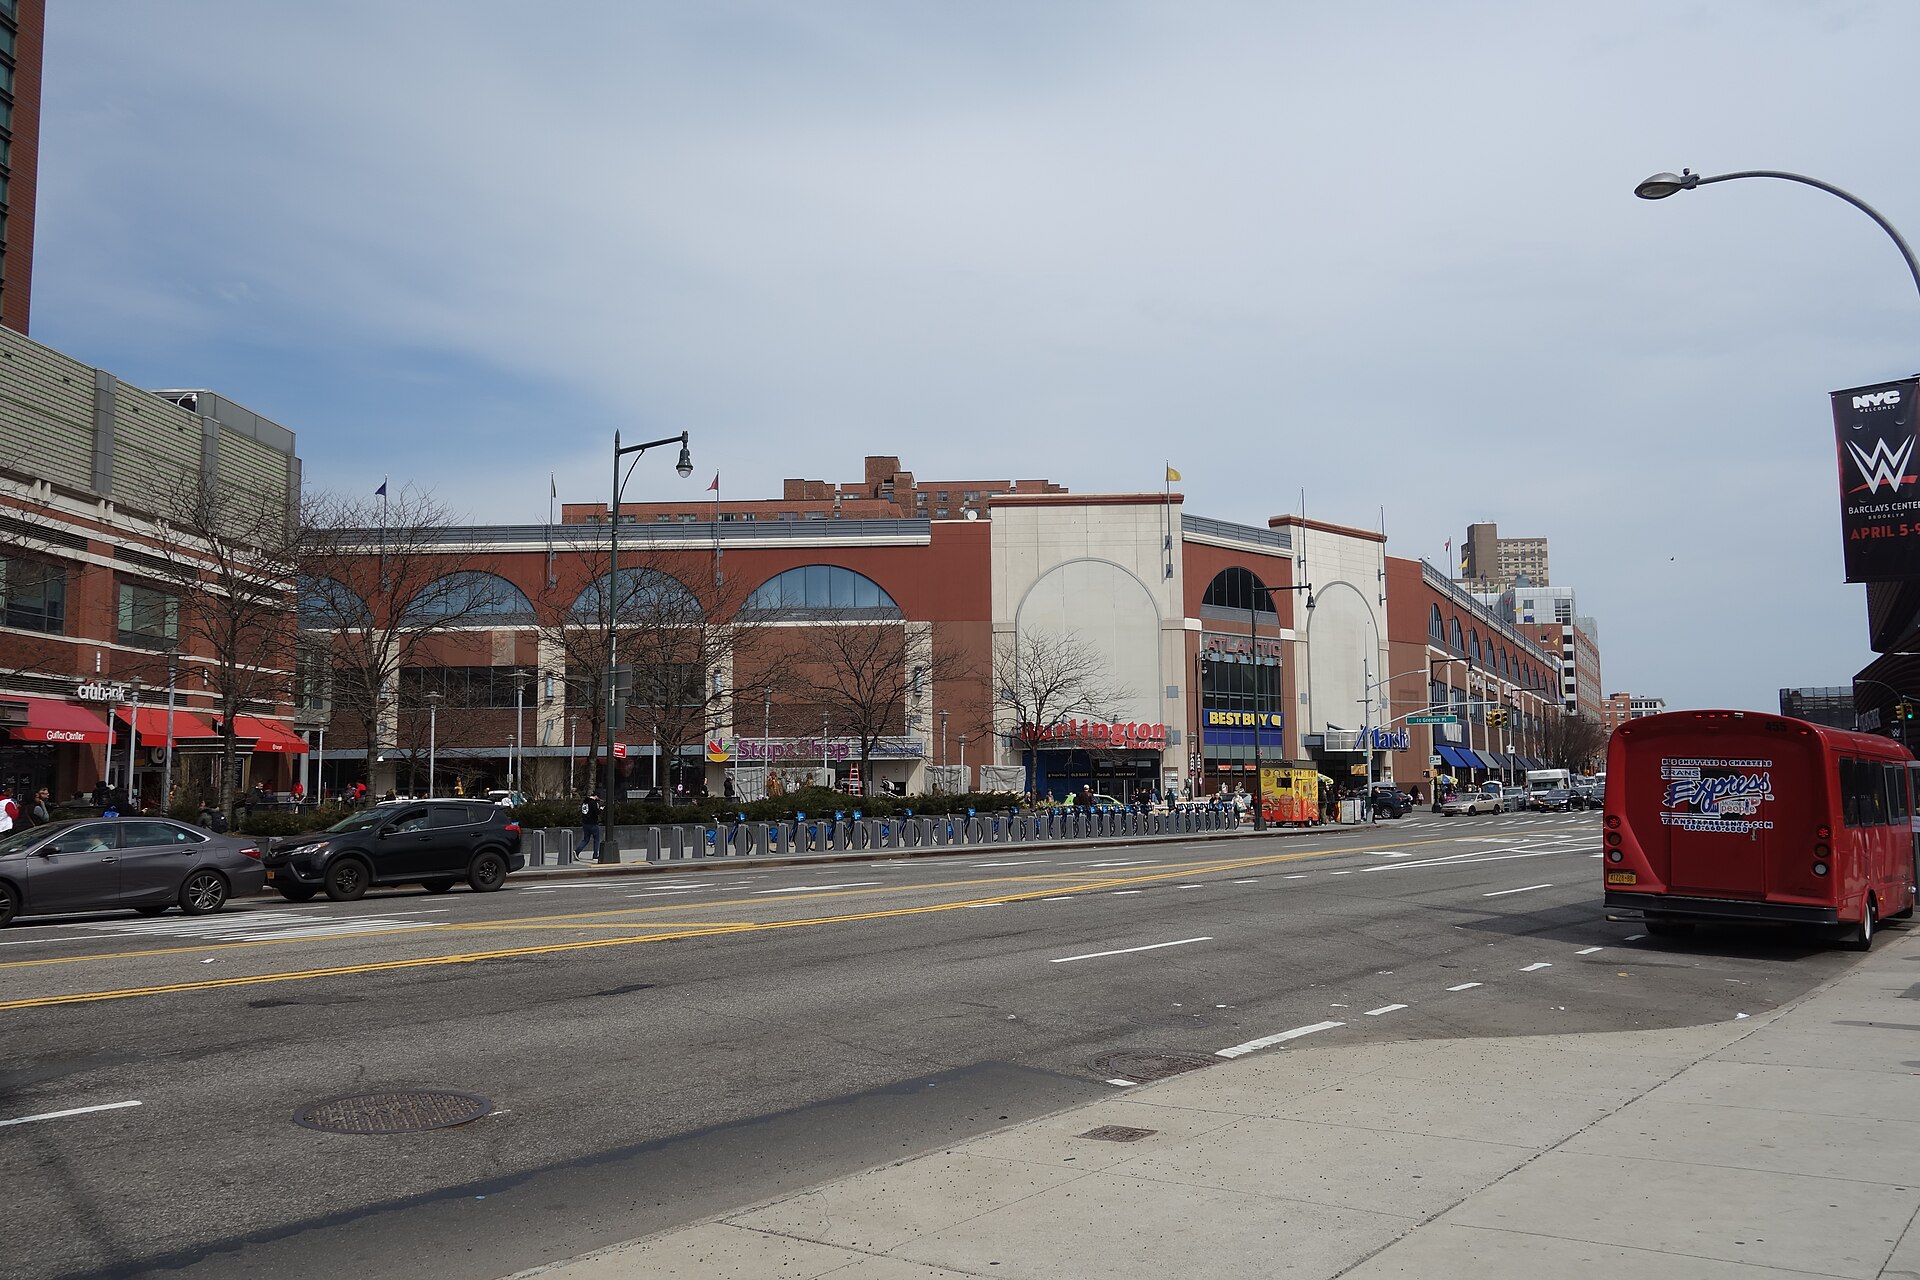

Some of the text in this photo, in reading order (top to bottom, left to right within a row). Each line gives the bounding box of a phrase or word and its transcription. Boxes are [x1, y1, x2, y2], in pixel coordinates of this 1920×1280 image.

[1852, 390, 1901, 409] NYC
[1859, 404, 1896, 413] WELCOMES
[1848, 503, 1890, 515] BARCLAYS
[1868, 512, 1905, 520] BROOKLYN
[1850, 525, 1895, 540] APRIL
[1207, 637, 1281, 656] ATLANTIC
[78, 682, 125, 701] citibank
[1209, 711, 1269, 726] BEST BUY
[46, 730, 85, 741] Guitar Center
[1020, 718, 1166, 746] Burlington
[1127, 740, 1167, 752] Factory
[1678, 759, 1719, 767] SHUTTLES
[1662, 769, 1699, 777] TRANS
[1663, 773, 1771, 812] Express
